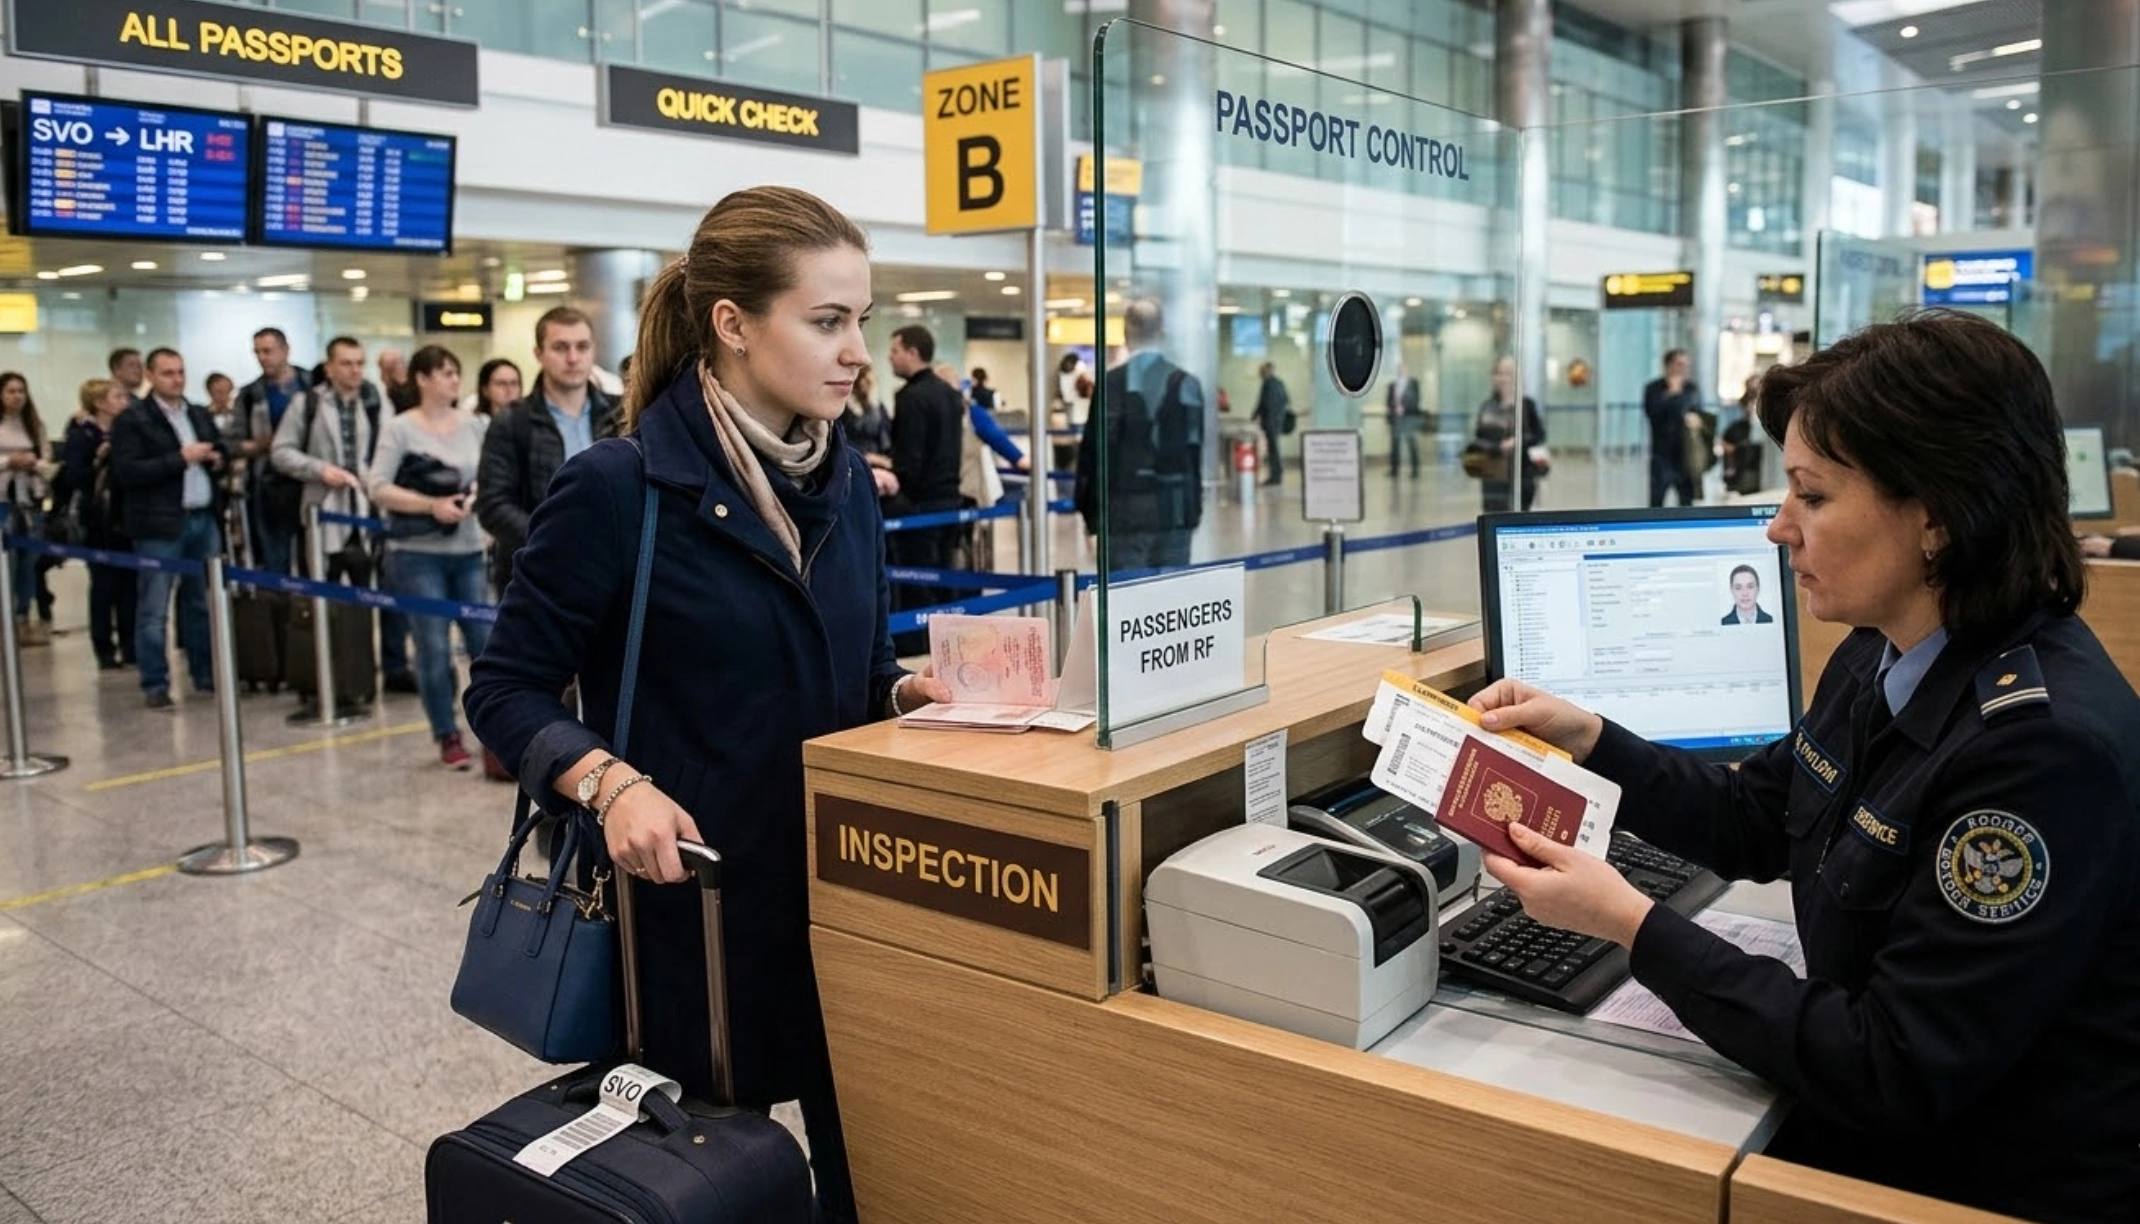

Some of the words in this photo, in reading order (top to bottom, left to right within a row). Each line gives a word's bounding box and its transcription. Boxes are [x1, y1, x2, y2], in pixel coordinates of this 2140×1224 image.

[120, 12, 189, 51] ALL
[199, 21, 403, 80] PASSPORTS
[656, 87, 737, 125] QUICK
[739, 100, 819, 136] CHECK
[937, 76, 1021, 119] ZONE
[32, 117, 94, 146] SVO
[139, 127, 194, 154] LHR
[1216, 89, 1360, 159] PASSPORT
[1366, 125, 1470, 181] CONTROL
[956, 134, 1005, 213] B
[1120, 599, 1232, 643] PASSENGERS
[1141, 641, 1189, 674] FROM
[1194, 635, 1215, 660] RF
[837, 822, 1060, 914] INSPECTION
[603, 1074, 643, 1103] SVO
